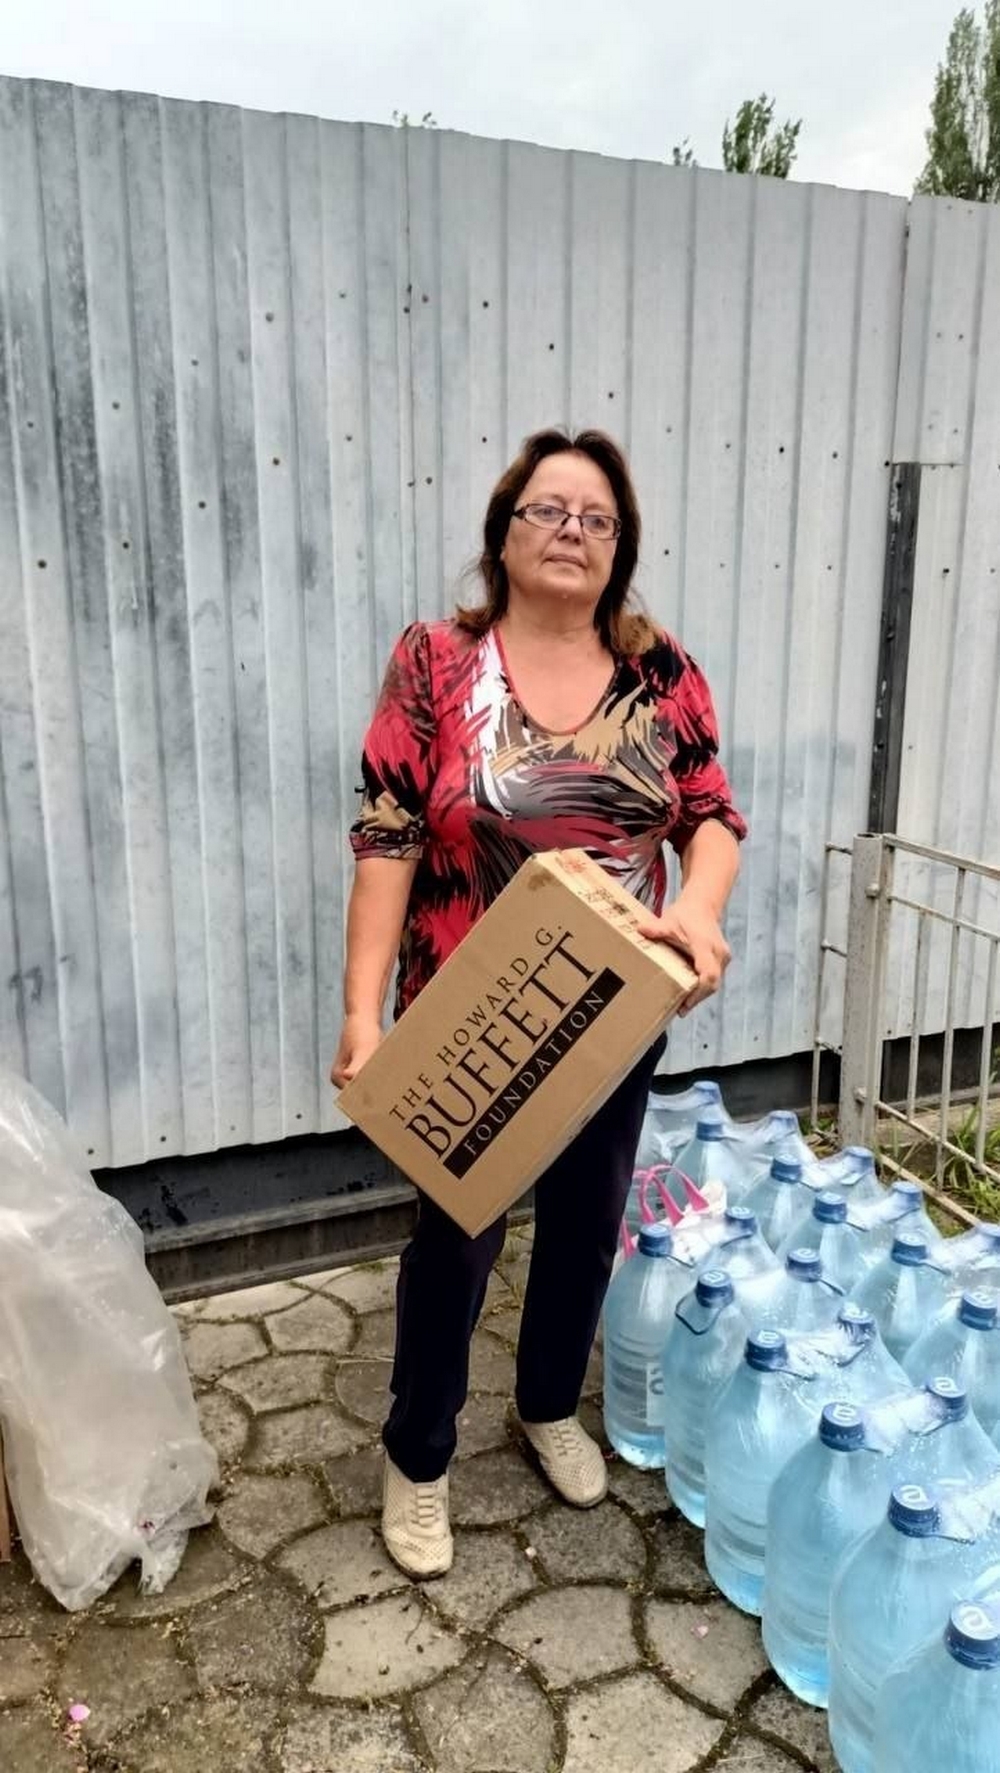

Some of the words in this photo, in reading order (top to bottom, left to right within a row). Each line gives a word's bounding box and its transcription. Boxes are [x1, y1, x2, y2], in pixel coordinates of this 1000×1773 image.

[389, 1072, 434, 1123] THE
[436, 957, 529, 1068] HOWARD
[534, 925, 563, 947] G.
[404, 931, 596, 1159] BUFFETT
[463, 990, 605, 1156] FOUNDATION
